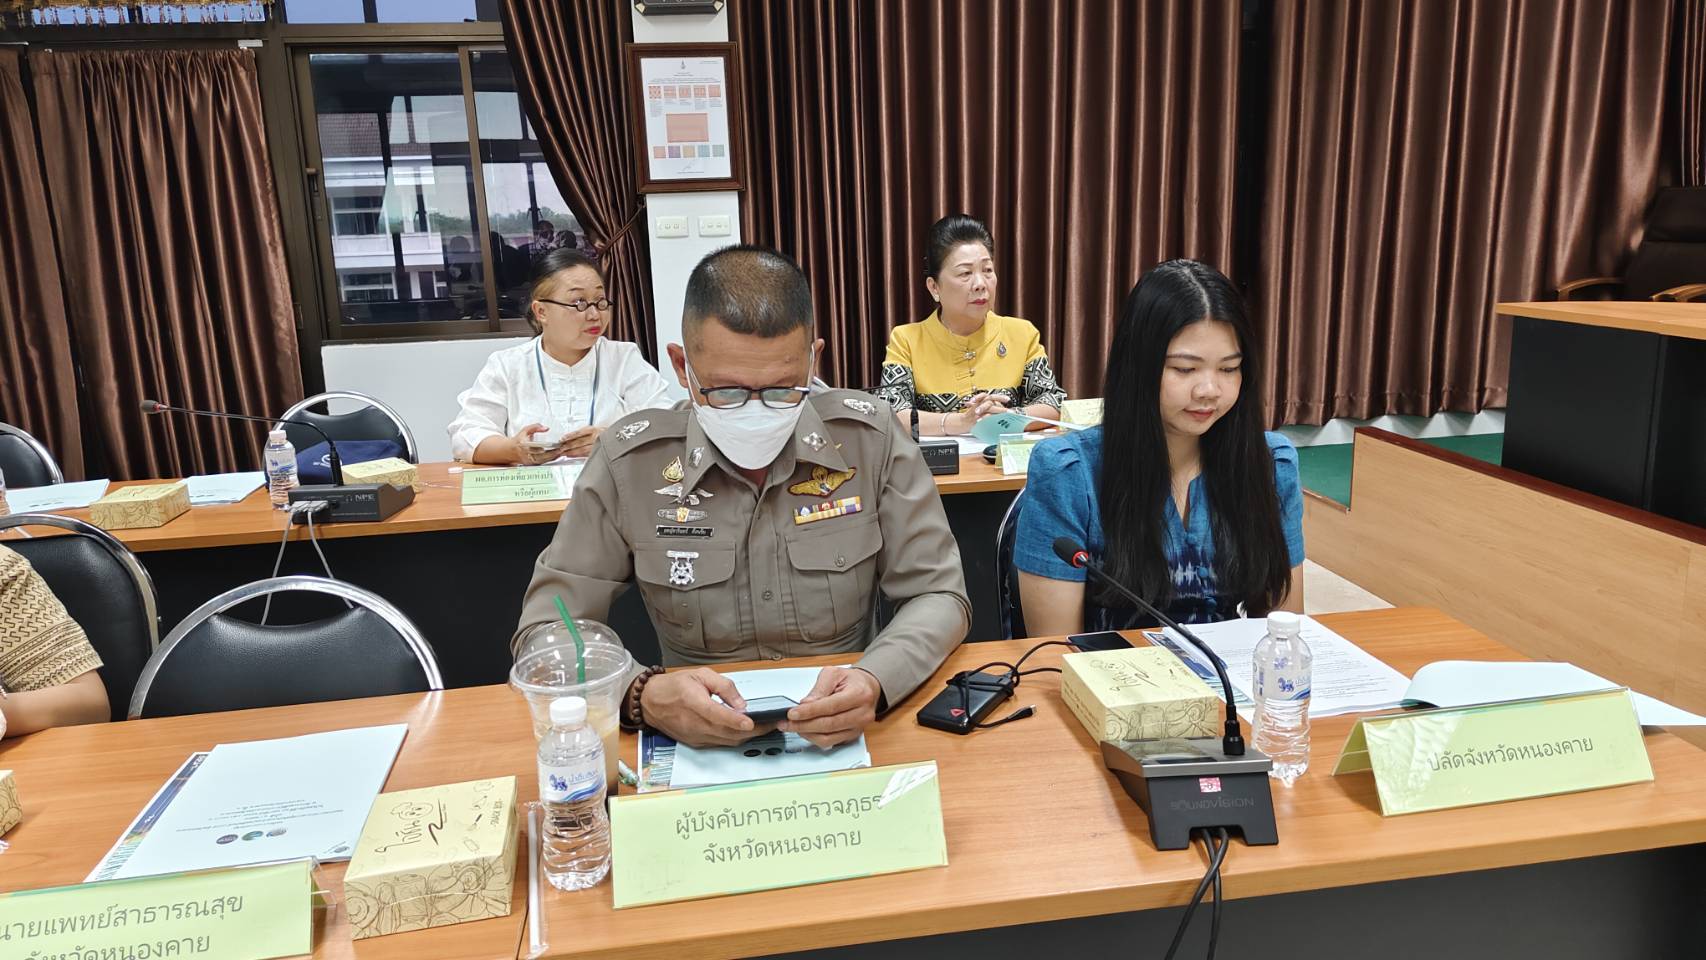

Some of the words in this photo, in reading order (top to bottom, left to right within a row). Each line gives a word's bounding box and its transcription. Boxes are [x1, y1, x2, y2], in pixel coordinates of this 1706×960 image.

[1427, 736, 1594, 772] ปลัดจังหวัดหนองคาย
[703, 829, 862, 864] จังหวัดหนองคาย
[0, 895, 243, 941] นายแพทย์สาธารณสุข
